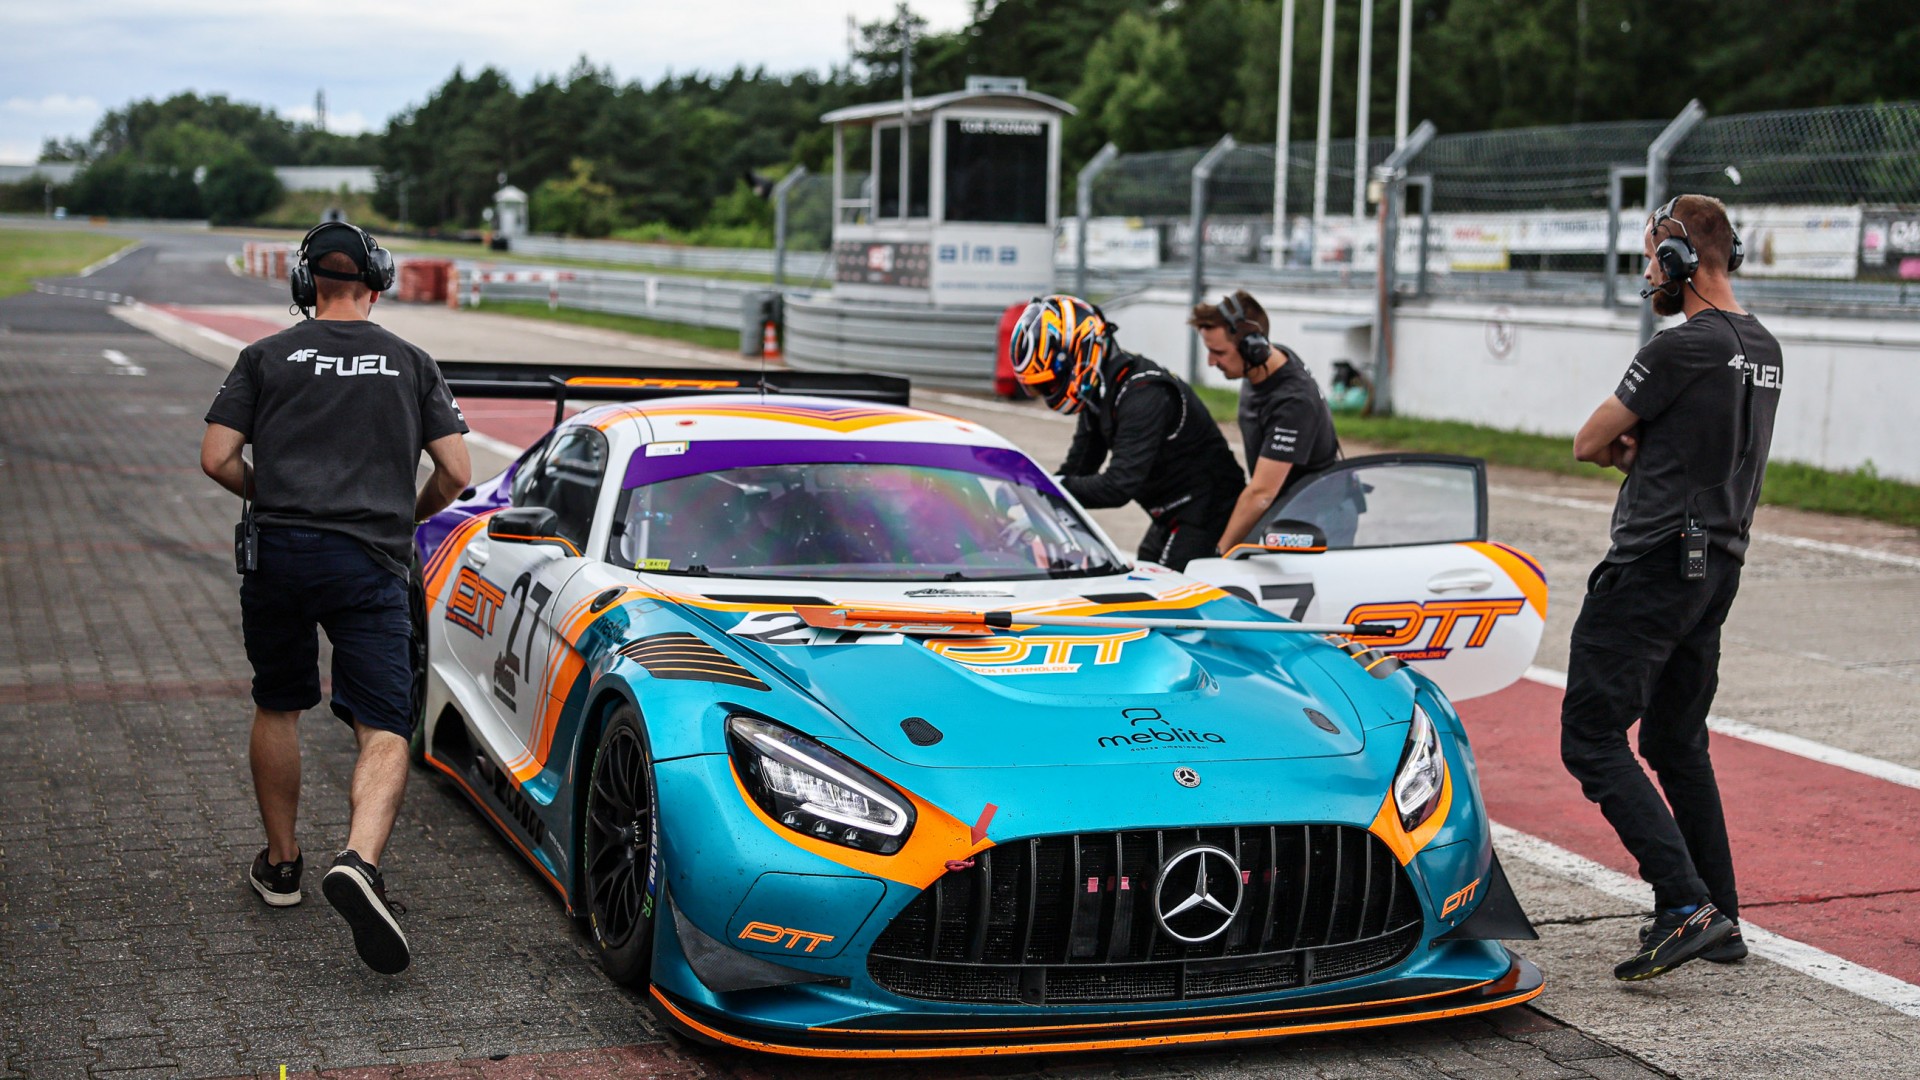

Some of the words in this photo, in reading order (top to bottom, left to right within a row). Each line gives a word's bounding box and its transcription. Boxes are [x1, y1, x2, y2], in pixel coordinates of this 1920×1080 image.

[286, 348, 318, 362] 4F
[314, 354, 400, 376] FUEL
[1727, 354, 1745, 370] 4F
[1742, 362, 1783, 390] FUEL
[510, 571, 553, 685] 27
[922, 627, 1150, 665] PTT
[1001, 665, 1075, 674] TECHNOLOGY
[1097, 727, 1227, 748] meblita
[1440, 877, 1480, 919] PTT
[737, 920, 836, 953] PTT
